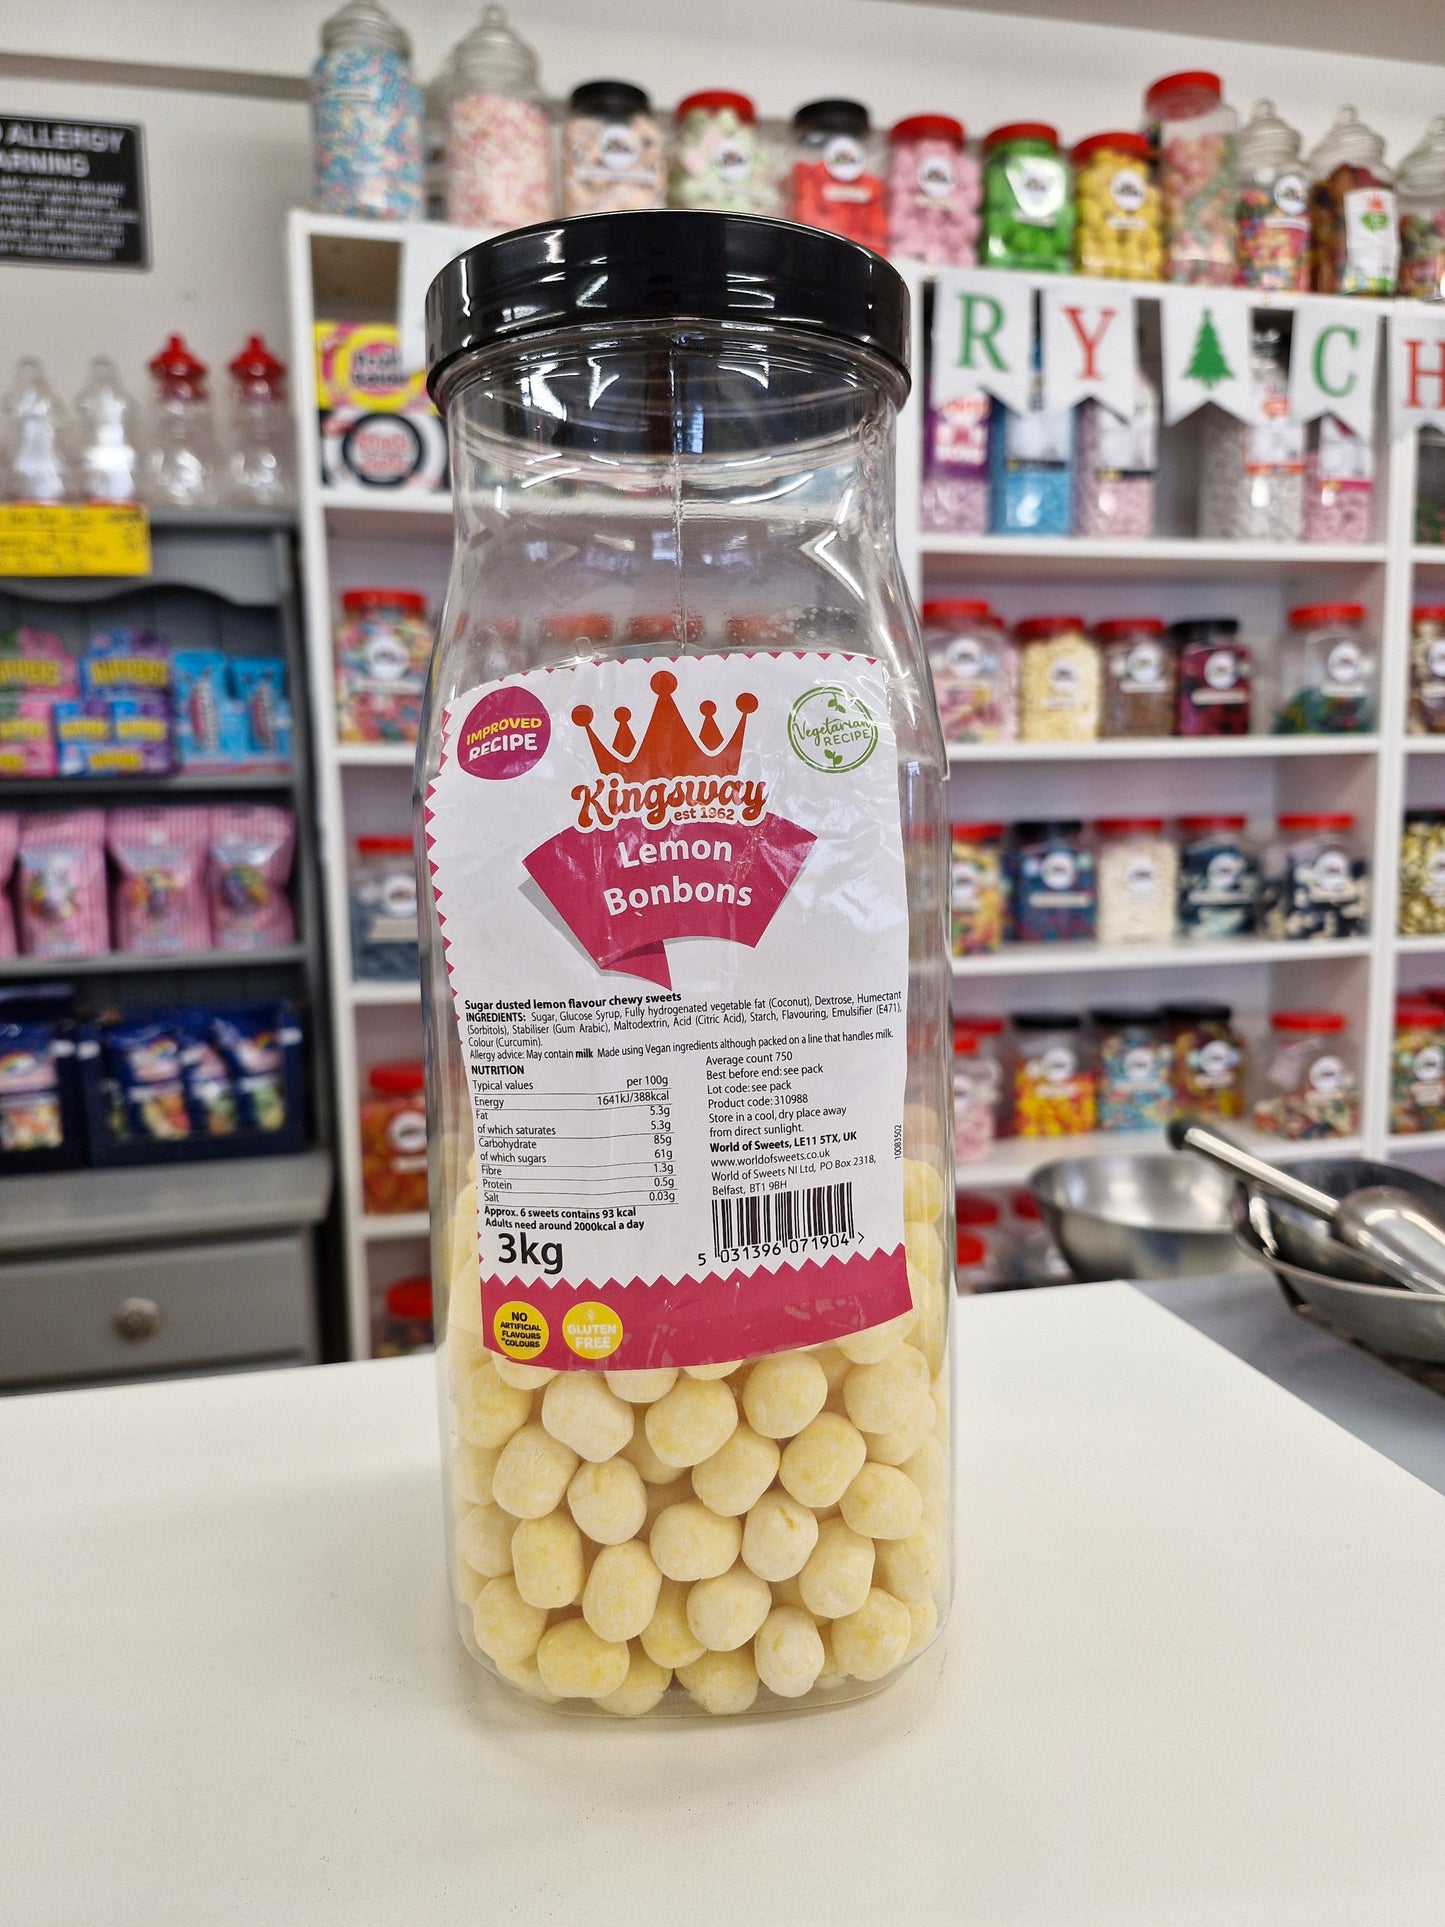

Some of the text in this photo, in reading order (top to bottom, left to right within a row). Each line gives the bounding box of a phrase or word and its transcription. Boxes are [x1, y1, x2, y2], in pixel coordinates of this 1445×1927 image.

[4, 124, 124, 152] ALLERGY
[466, 717, 542, 745] IMPROVED
[792, 715, 871, 746] Vegetarian
[824, 729, 870, 747] RECIPE
[468, 734, 537, 761] RECIPE
[571, 774, 768, 828] Kingsway
[674, 807, 735, 821] est 1962
[618, 837, 732, 869] Lemon
[603, 876, 752, 915] Bonbons
[465, 992, 681, 1011] Sugar dusted lemon flavour chewy sweets
[466, 991, 901, 1023] INGREDIENTS: Sugar, Glucose Syrup, Fully hydrogenated vegetable fat (Coconut), Dextrose, Humectant
[467, 1003, 901, 1035] (Sorbitols), Stabiliser (Gum Arabic), Maltodextrin, Acid (Citric Acid), Starch, Flavouring, Emulsifier (E471),
[469, 1037, 543, 1047] Colour (Curcumin).
[470, 1050, 495, 1061] Allergy
[497, 1050, 524, 1059] advice:
[526, 1050, 542, 1060] May
[544, 1049, 573, 1058] contain
[576, 1049, 593, 1058] milk
[597, 1047, 619, 1057] Made
[622, 1046, 643, 1056] using
[645, 1043, 670, 1055] Vegan
[673, 1040, 718, 1054] ingredients
[720, 1037, 756, 1049] although
[759, 1035, 787, 1047] packed
[789, 1036, 799, 1044] on
[808, 1033, 823, 1043] line
[825, 1032, 840, 1042] that
[843, 1030, 873, 1041] handles
[876, 1028, 893, 1039] milk.
[706, 1052, 792, 1066] Average count 750
[472, 1066, 524, 1074] NUTRITION
[707, 1070, 726, 1079] Best
[729, 1069, 759, 1078] before
[762, 1068, 782, 1077] end:
[802, 1064, 823, 1076] pack
[473, 1076, 668, 1091] Typical values per 100g
[707, 1081, 792, 1094] Lot code: see pack
[475, 1091, 669, 1109] Energy 1641kJ/388kcal
[708, 1094, 808, 1109] Product code: 310988
[476, 1106, 670, 1119] Fat 5.3g
[709, 1114, 733, 1123] Store
[736, 1112, 743, 1122] in
[755, 1111, 777, 1121] cool,
[779, 1110, 794, 1121] dry
[797, 1107, 820, 1120] place
[823, 1107, 846, 1117] away
[477, 1120, 671, 1135] of which saturates 5.3g
[710, 1123, 804, 1137] from direct sunlight.
[479, 1135, 672, 1150] Carbohydrate 85g
[710, 1132, 857, 1152] World of Sweets, LE11 5TX, UK
[480, 1149, 672, 1165] of which sugars 61g
[711, 1149, 830, 1168] www.worldofsweets.co.uk
[482, 1163, 673, 1175] Fibre 1.3g
[711, 1155, 876, 1182] World of Sweets NI Ltd, PO Box 2318,
[483, 1178, 674, 1189] Protein 0.5g
[713, 1181, 787, 1195] Belfast, BT1 9BH
[484, 1192, 675, 1202] Salt 0.03g
[485, 1207, 636, 1219] Approx. 6 sweets contains 93 kcal
[486, 1218, 513, 1228] Adults
[515, 1221, 536, 1229] need
[539, 1221, 572, 1230] around
[574, 1221, 616, 1231] 2000kcal
[627, 1220, 644, 1230] day
[499, 1232, 564, 1274] 3kg
[698, 1234, 849, 1266] 5 031396 071904
[512, 1312, 527, 1321] NO
[500, 1322, 541, 1331] ARTIFICIAL
[567, 1324, 616, 1334] GLUTEN
[502, 1331, 541, 1339] FLAVOURS
[505, 1340, 540, 1348] COLOURS
[576, 1338, 610, 1349] FREE
